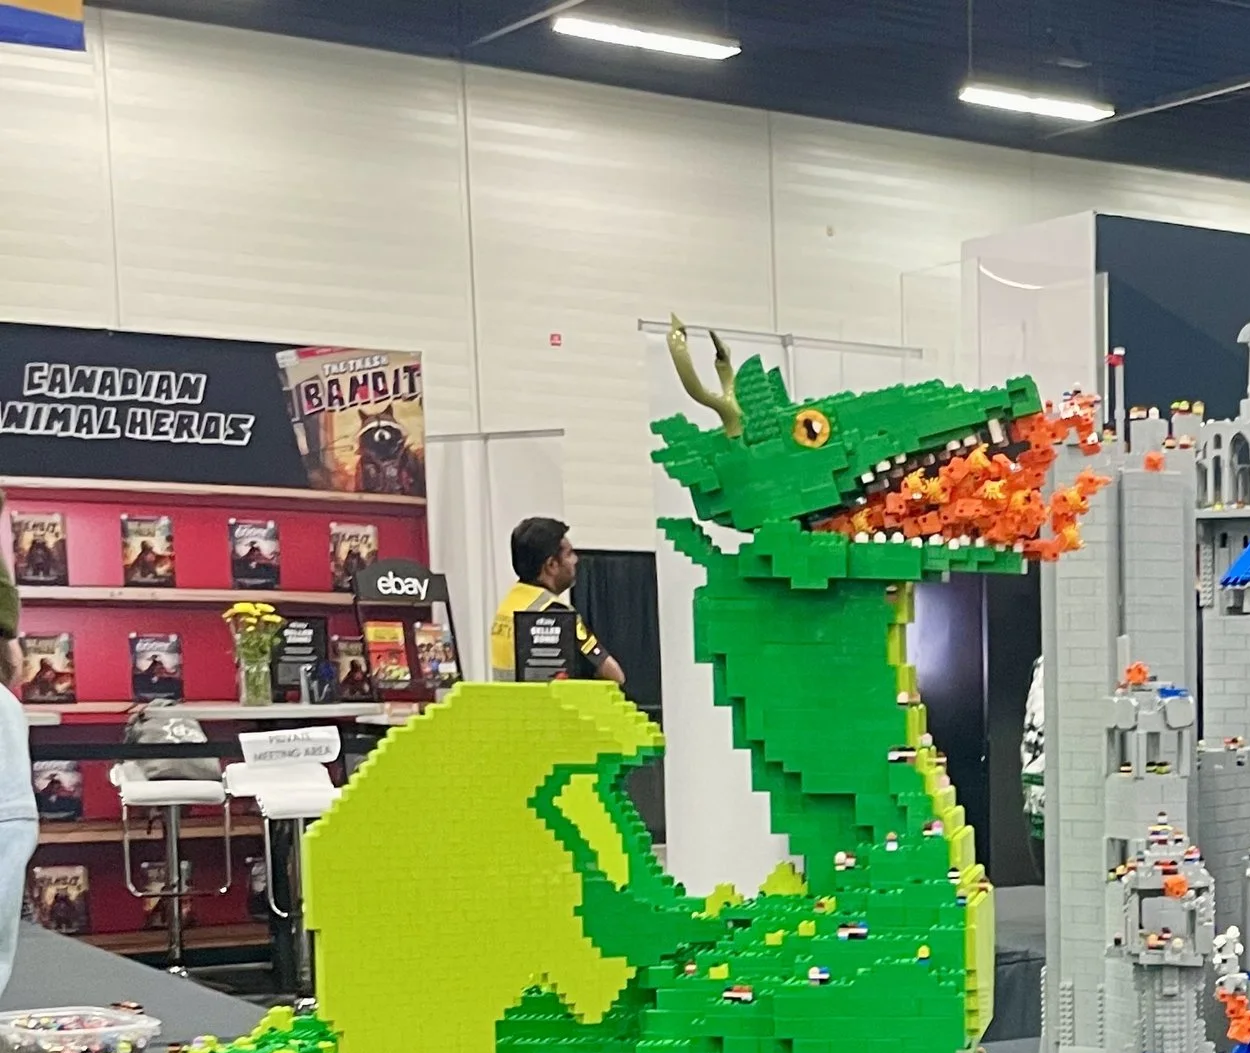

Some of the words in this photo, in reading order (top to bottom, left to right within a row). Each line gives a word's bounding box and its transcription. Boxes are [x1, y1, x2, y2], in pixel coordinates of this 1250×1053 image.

[23, 362, 207, 404] CANADIAN
[300, 362, 422, 416] BANDIT
[0, 401, 121, 439] NIMAL
[125, 408, 255, 446] HEROS
[376, 570, 430, 600] ebay
